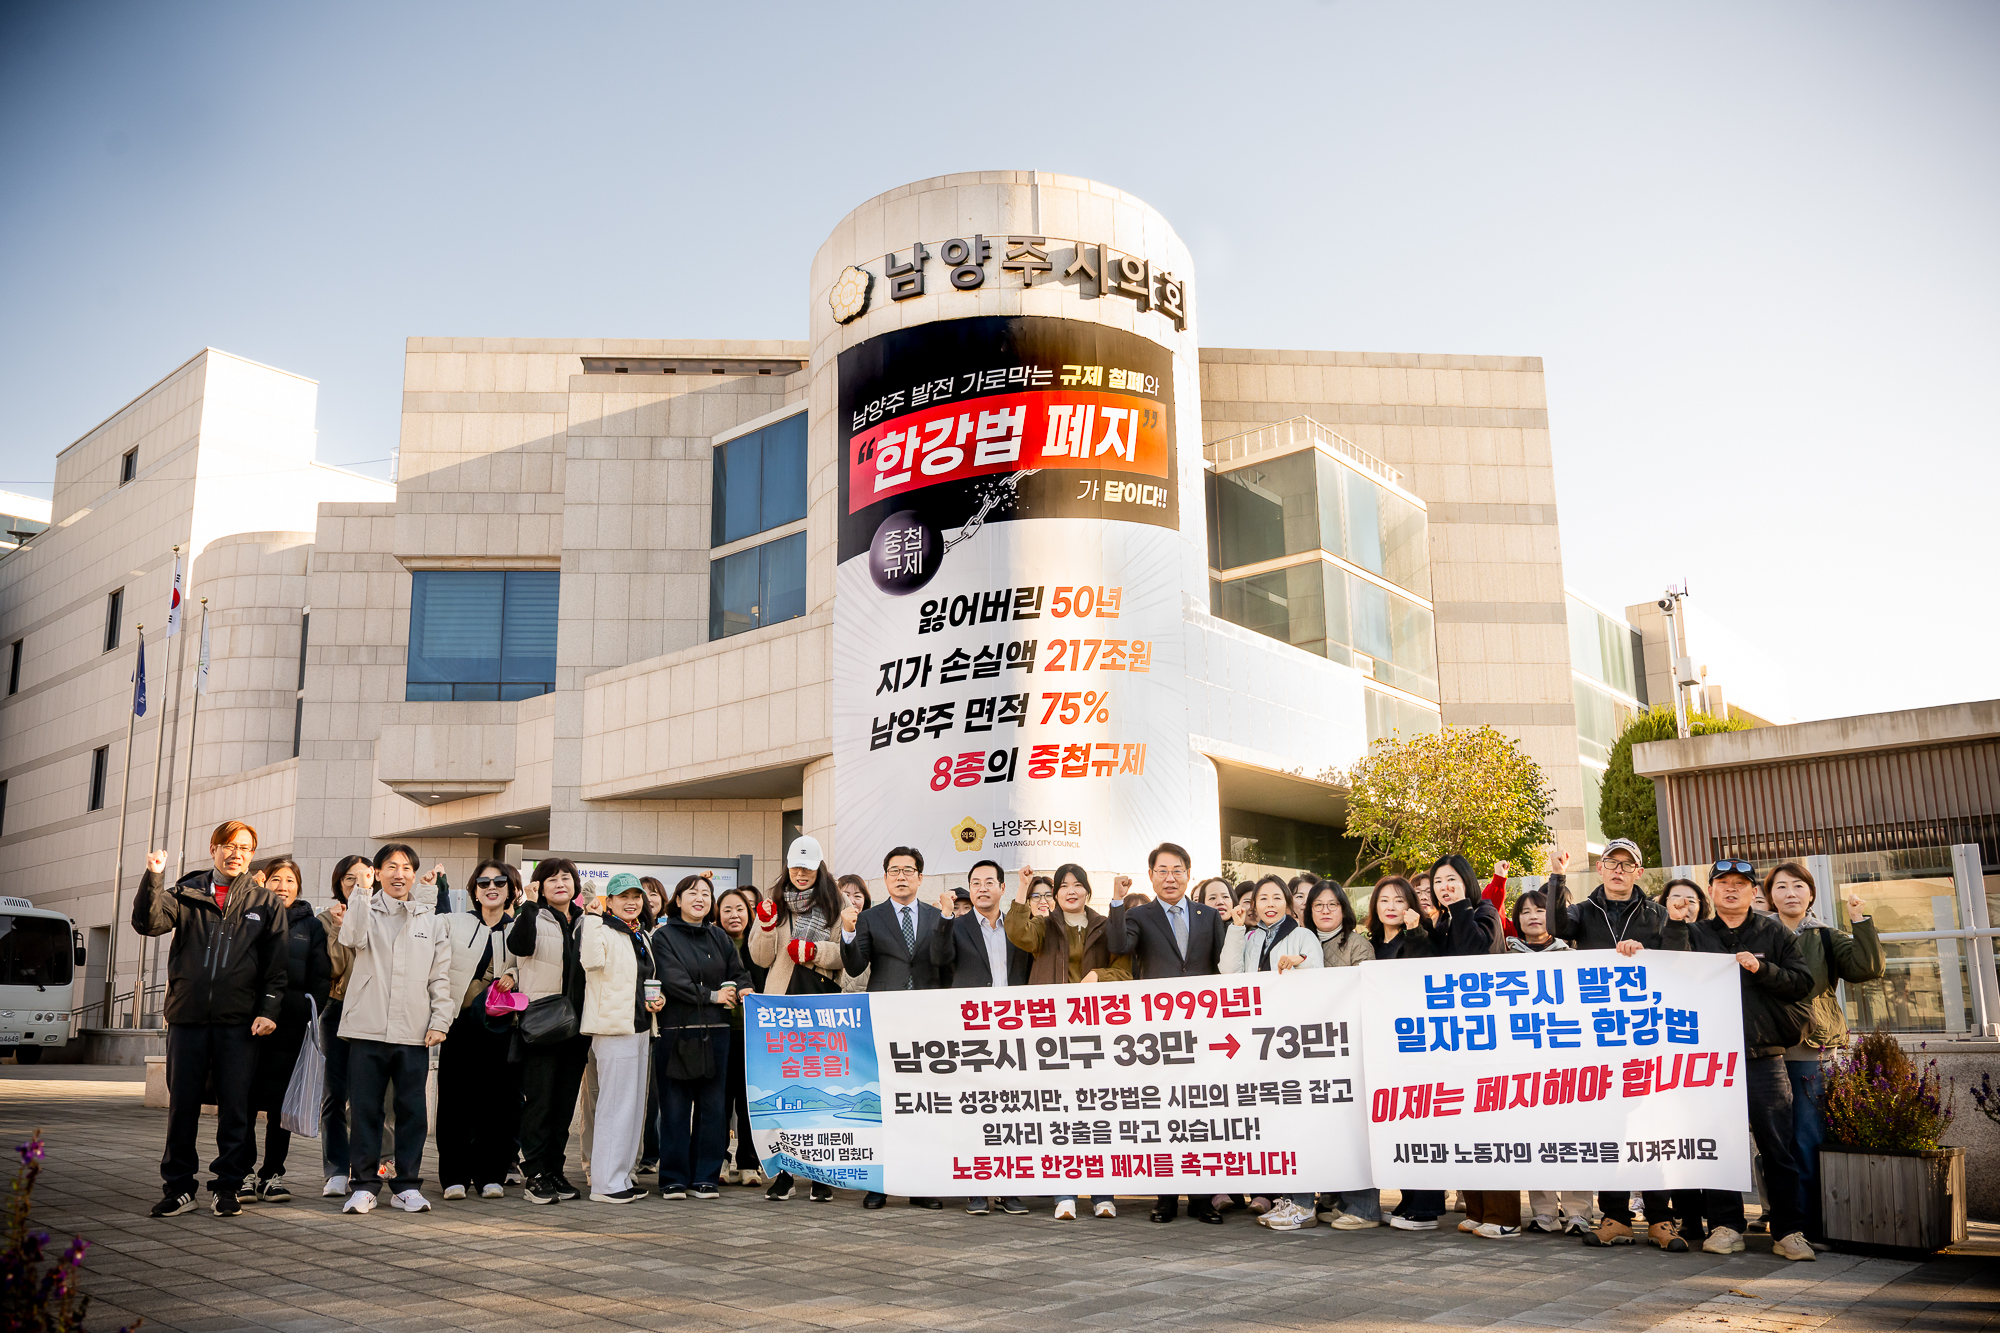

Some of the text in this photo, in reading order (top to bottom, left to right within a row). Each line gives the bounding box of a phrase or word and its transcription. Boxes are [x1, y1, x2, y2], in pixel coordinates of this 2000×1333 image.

[885, 234, 1187, 331] 남양주시의회
[852, 364, 1160, 431] 남양주 발전 가로막는 규제 철폐와
[1076, 479, 1167, 509] 가 답이다!!
[884, 526, 923, 555] 중첩
[883, 550, 923, 579] 규제
[918, 586, 1123, 635] 잃어버린 50년
[876, 639, 1152, 696] 지가 손실액 217조원
[869, 690, 1110, 751] 남양주 면적 75%
[929, 742, 1148, 792] 8종의 중첩규제
[992, 819, 1082, 837] 남양주시의회
[993, 839, 1036, 849] NAMYANGJU
[1053, 840, 1081, 848] COUNCIL
[1424, 965, 1661, 1010] 남양주시 발전,
[756, 1006, 862, 1029] 한강법 폐지!
[960, 986, 1262, 1030] 한강법 제정 1999년!
[765, 1031, 849, 1053] 남양주에
[1394, 1007, 1699, 1053] 일자리 막는 한강법
[890, 1022, 1350, 1073] 남양주시 인구 33만 73만!
[781, 1055, 850, 1079] 숨통을!
[894, 1078, 1354, 1115] 도시는 성장했지만, 한강법은 시민의 발목을 잡고
[1371, 1051, 1738, 1123] 이제는 폐지해야 합니다!
[779, 1132, 853, 1146] 한강법 때문에
[982, 1117, 1260, 1146] 일자리 창출을 막고 있습니다!
[800, 1148, 834, 1161] 발전이
[838, 1148, 873, 1161] 멈췄다
[952, 1151, 1297, 1180] 노동자도 한강법 폐지를 촉구합니다!
[1393, 1138, 1718, 1165] 시민과 노동자의 생존권을 지켜주세요
[826, 1168, 868, 1180] 가로막는
